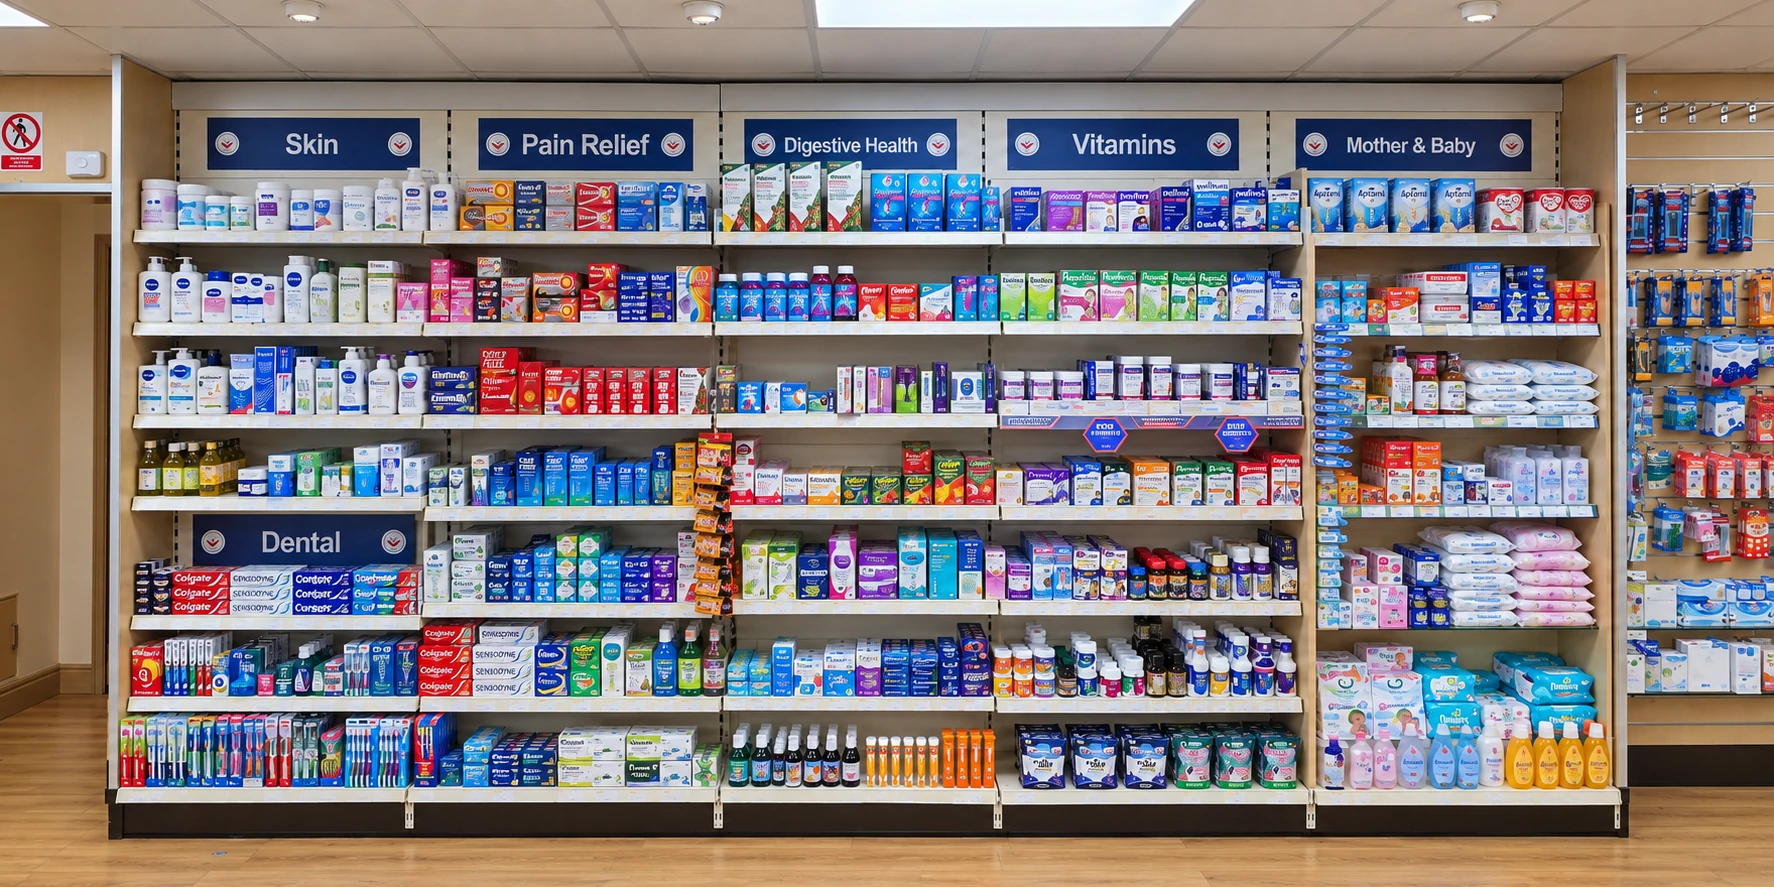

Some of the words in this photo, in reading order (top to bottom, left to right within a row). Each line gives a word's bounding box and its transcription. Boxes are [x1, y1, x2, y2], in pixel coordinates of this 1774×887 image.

[285, 132, 338, 155] Skin
[522, 133, 574, 155] Pain
[581, 133, 650, 155] Relief
[784, 136, 861, 158] Digestive
[865, 136, 918, 154] Health
[1071, 133, 1177, 155] Vitamins
[1347, 136, 1409, 154] Mother
[1412, 137, 1426, 154] &
[1431, 136, 1477, 158] Baby
[262, 530, 341, 553] Dental
[174, 573, 212, 586] Colgate
[174, 588, 212, 600] Colgate
[174, 602, 212, 614] Colgate
